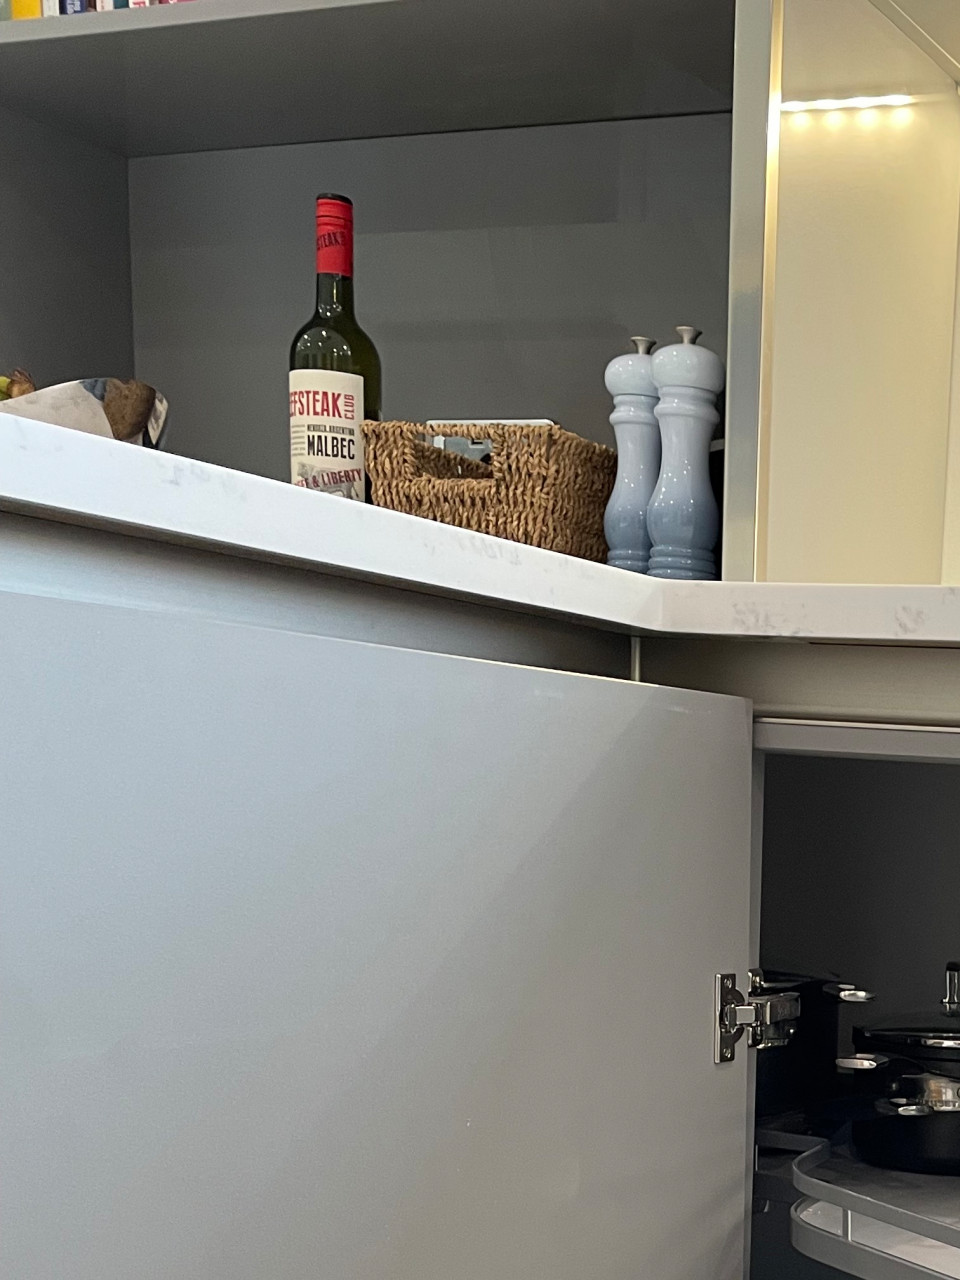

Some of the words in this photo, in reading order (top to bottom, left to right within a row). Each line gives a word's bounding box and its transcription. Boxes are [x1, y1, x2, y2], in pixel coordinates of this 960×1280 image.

[343, 394, 355, 420] CLUB
[307, 434, 355, 460] MALBEC
[312, 475, 320, 488] &
[321, 468, 362, 486] LIBERTY
